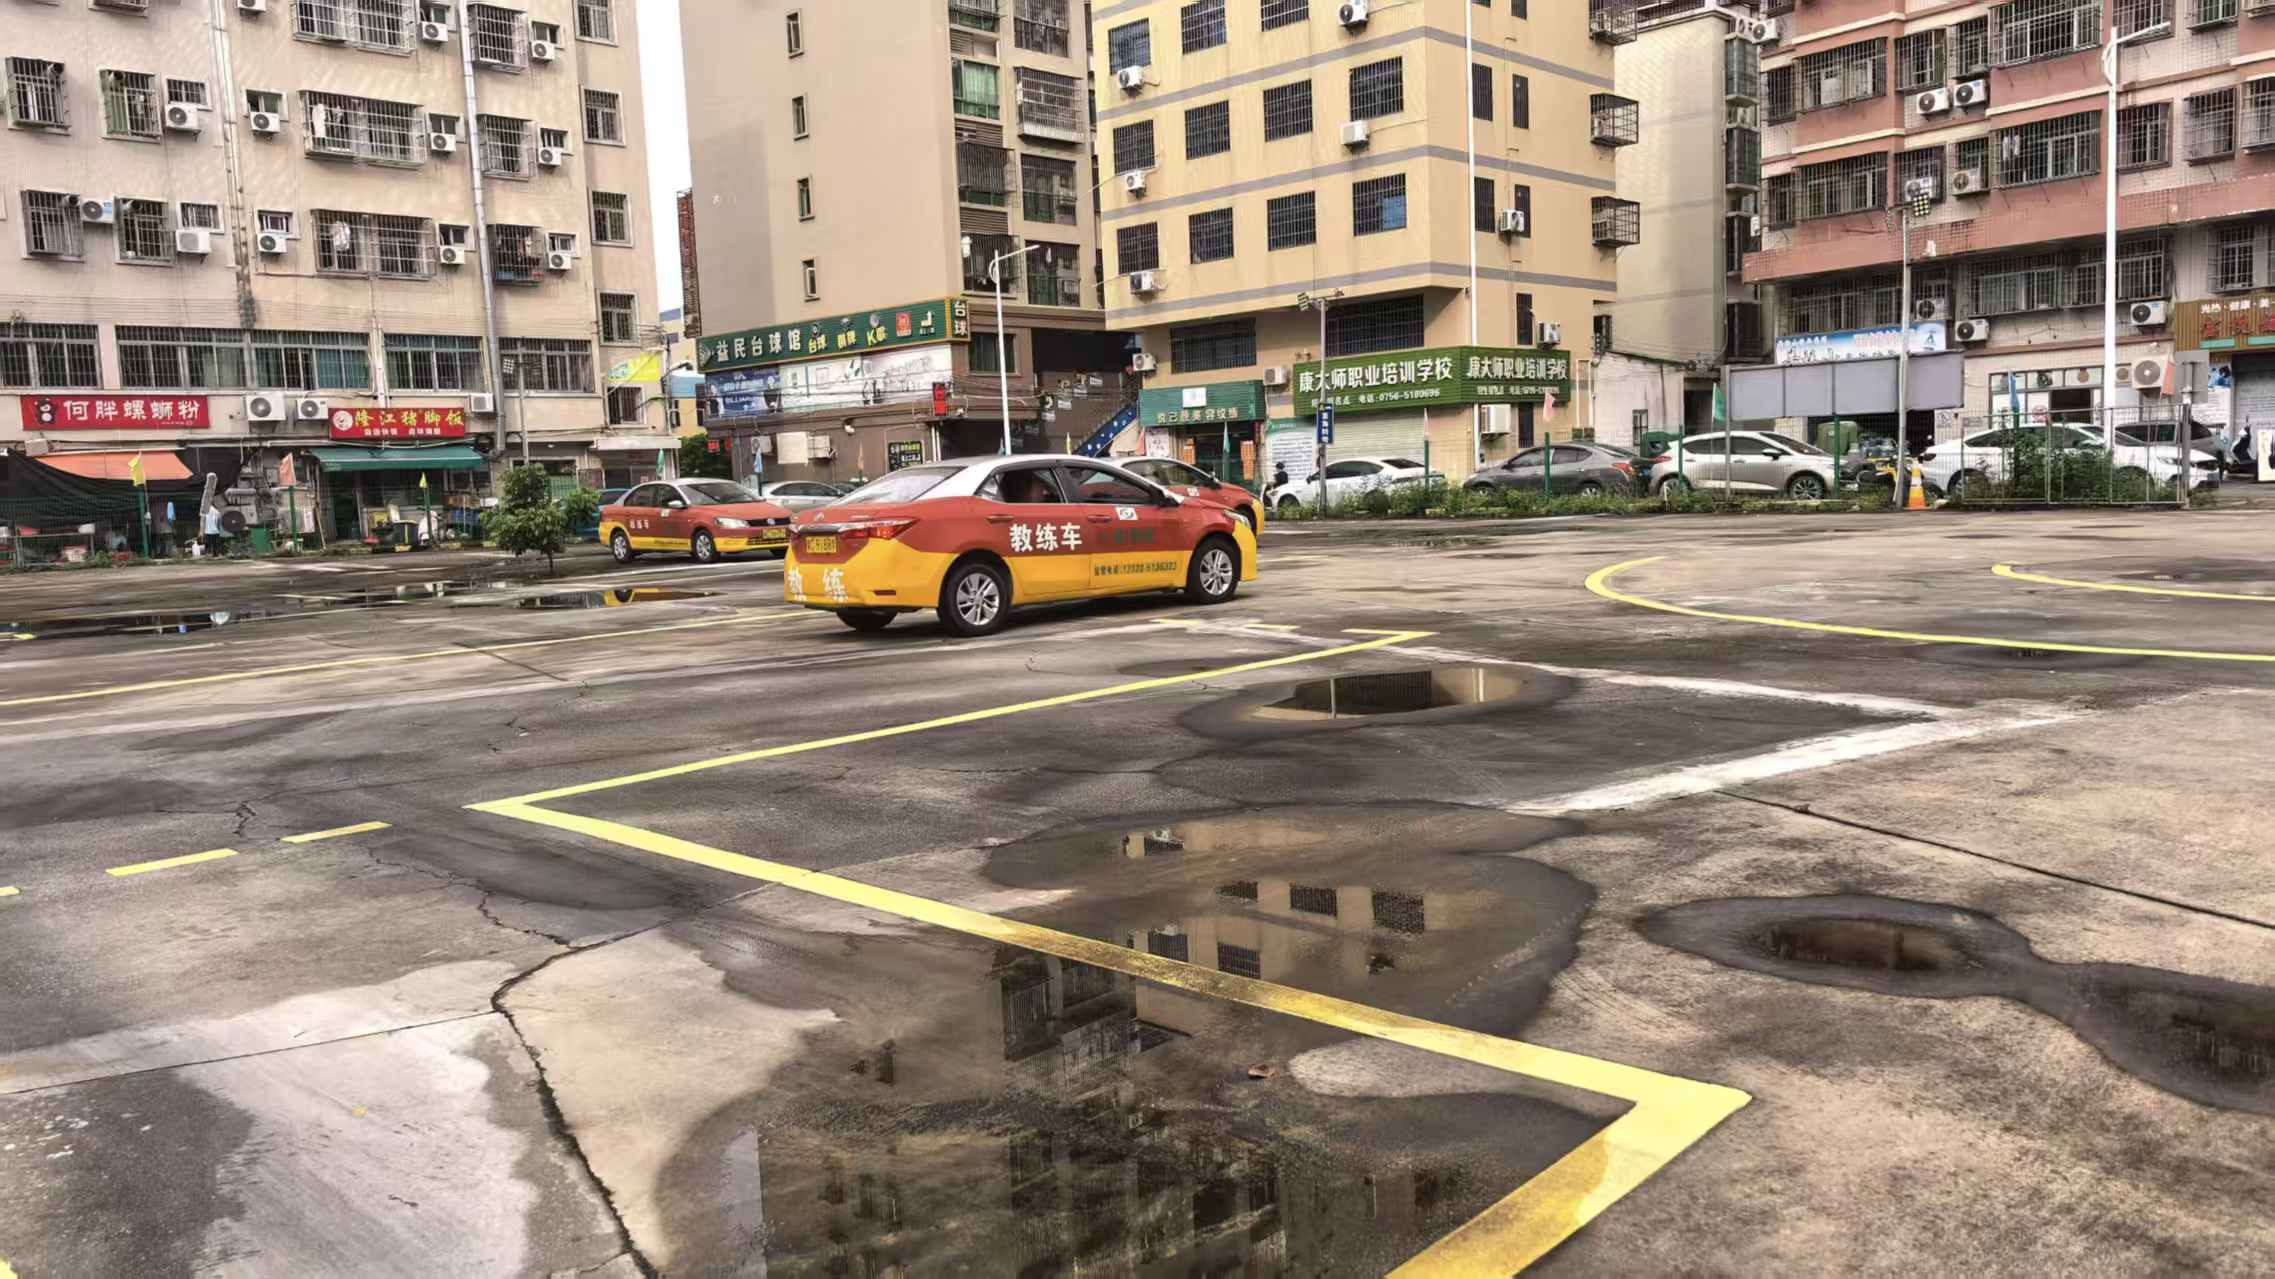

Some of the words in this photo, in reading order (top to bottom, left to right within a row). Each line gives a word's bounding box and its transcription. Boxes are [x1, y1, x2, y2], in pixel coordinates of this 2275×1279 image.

[954, 301, 968, 336] 台球
[716, 328, 801, 363] 益民台球馆
[1299, 357, 1454, 393] 康大师职业培训学校
[1466, 356, 1568, 379] 康大师职业培训学校
[63, 399, 201, 421] 何胖螺蛳粉
[355, 409, 464, 427] 隆江猪脚饭
[1009, 522, 1083, 552] 教练车
